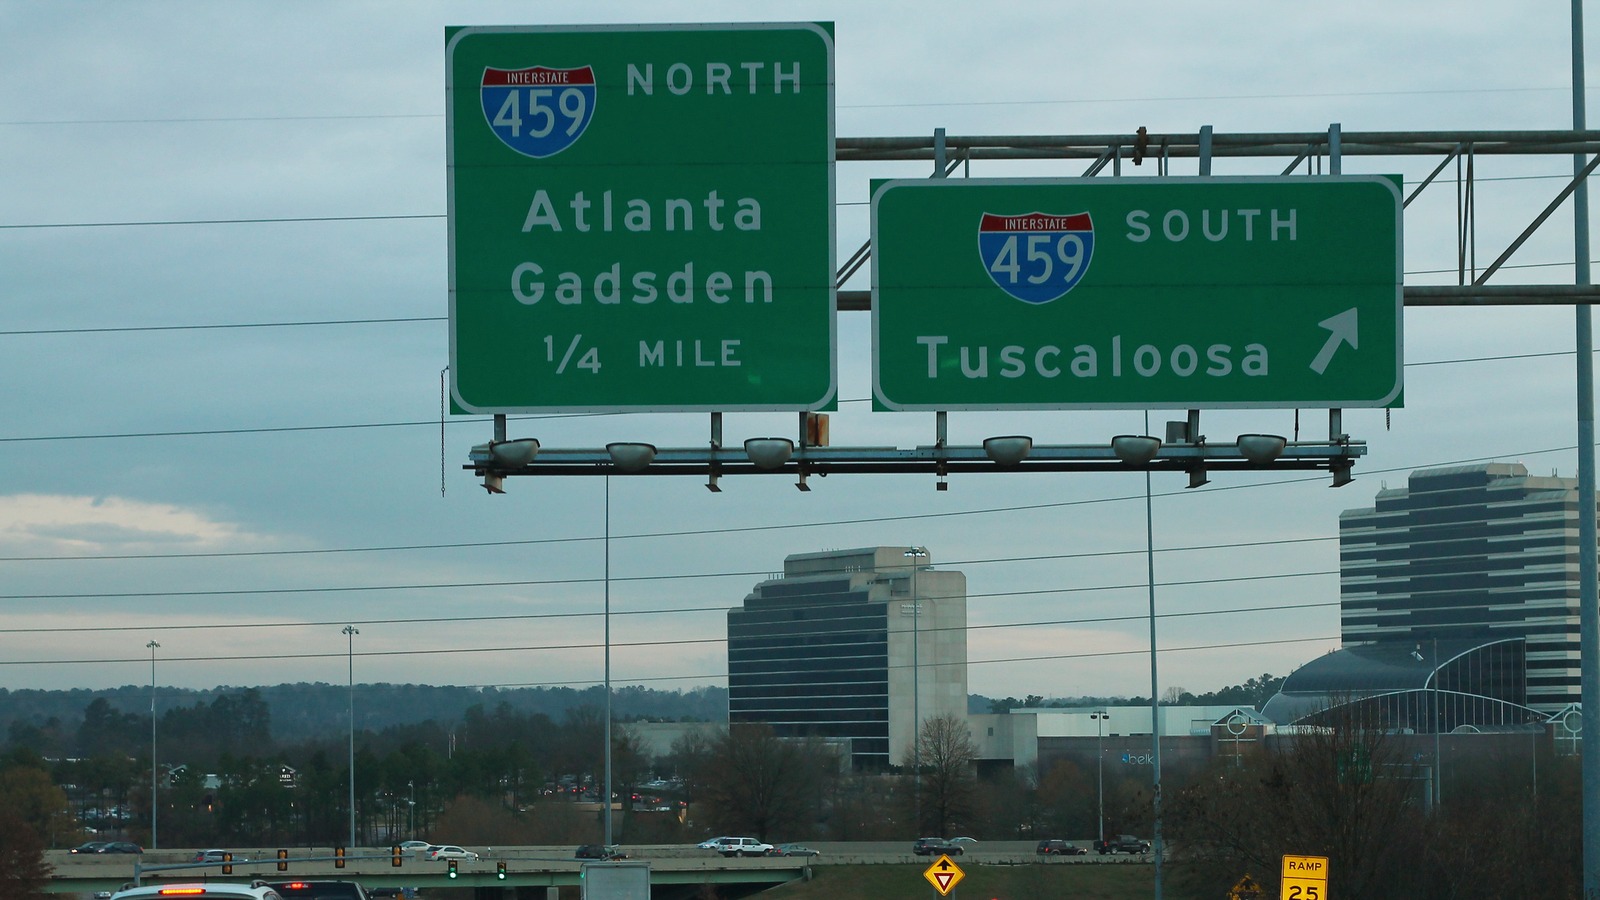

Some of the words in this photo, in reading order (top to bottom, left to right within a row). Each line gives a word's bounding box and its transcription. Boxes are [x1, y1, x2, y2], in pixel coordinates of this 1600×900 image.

[507, 71, 569, 84] INTERSTATE
[627, 62, 801, 96] NORTH
[492, 87, 586, 138] 459
[522, 190, 761, 233] Atlanta
[1005, 218, 1067, 230] INTERSTATE
[1125, 208, 1297, 243] SOUTH
[990, 233, 1085, 285] 459
[511, 262, 773, 306] Gadsden
[543, 333, 602, 374] 1/4
[639, 339, 742, 367] MILE
[916, 335, 1269, 379] Tuscaloosa
[1128, 753, 1154, 765] belk
[1289, 861, 1322, 871] RAMP
[1288, 885, 1319, 900] 25
